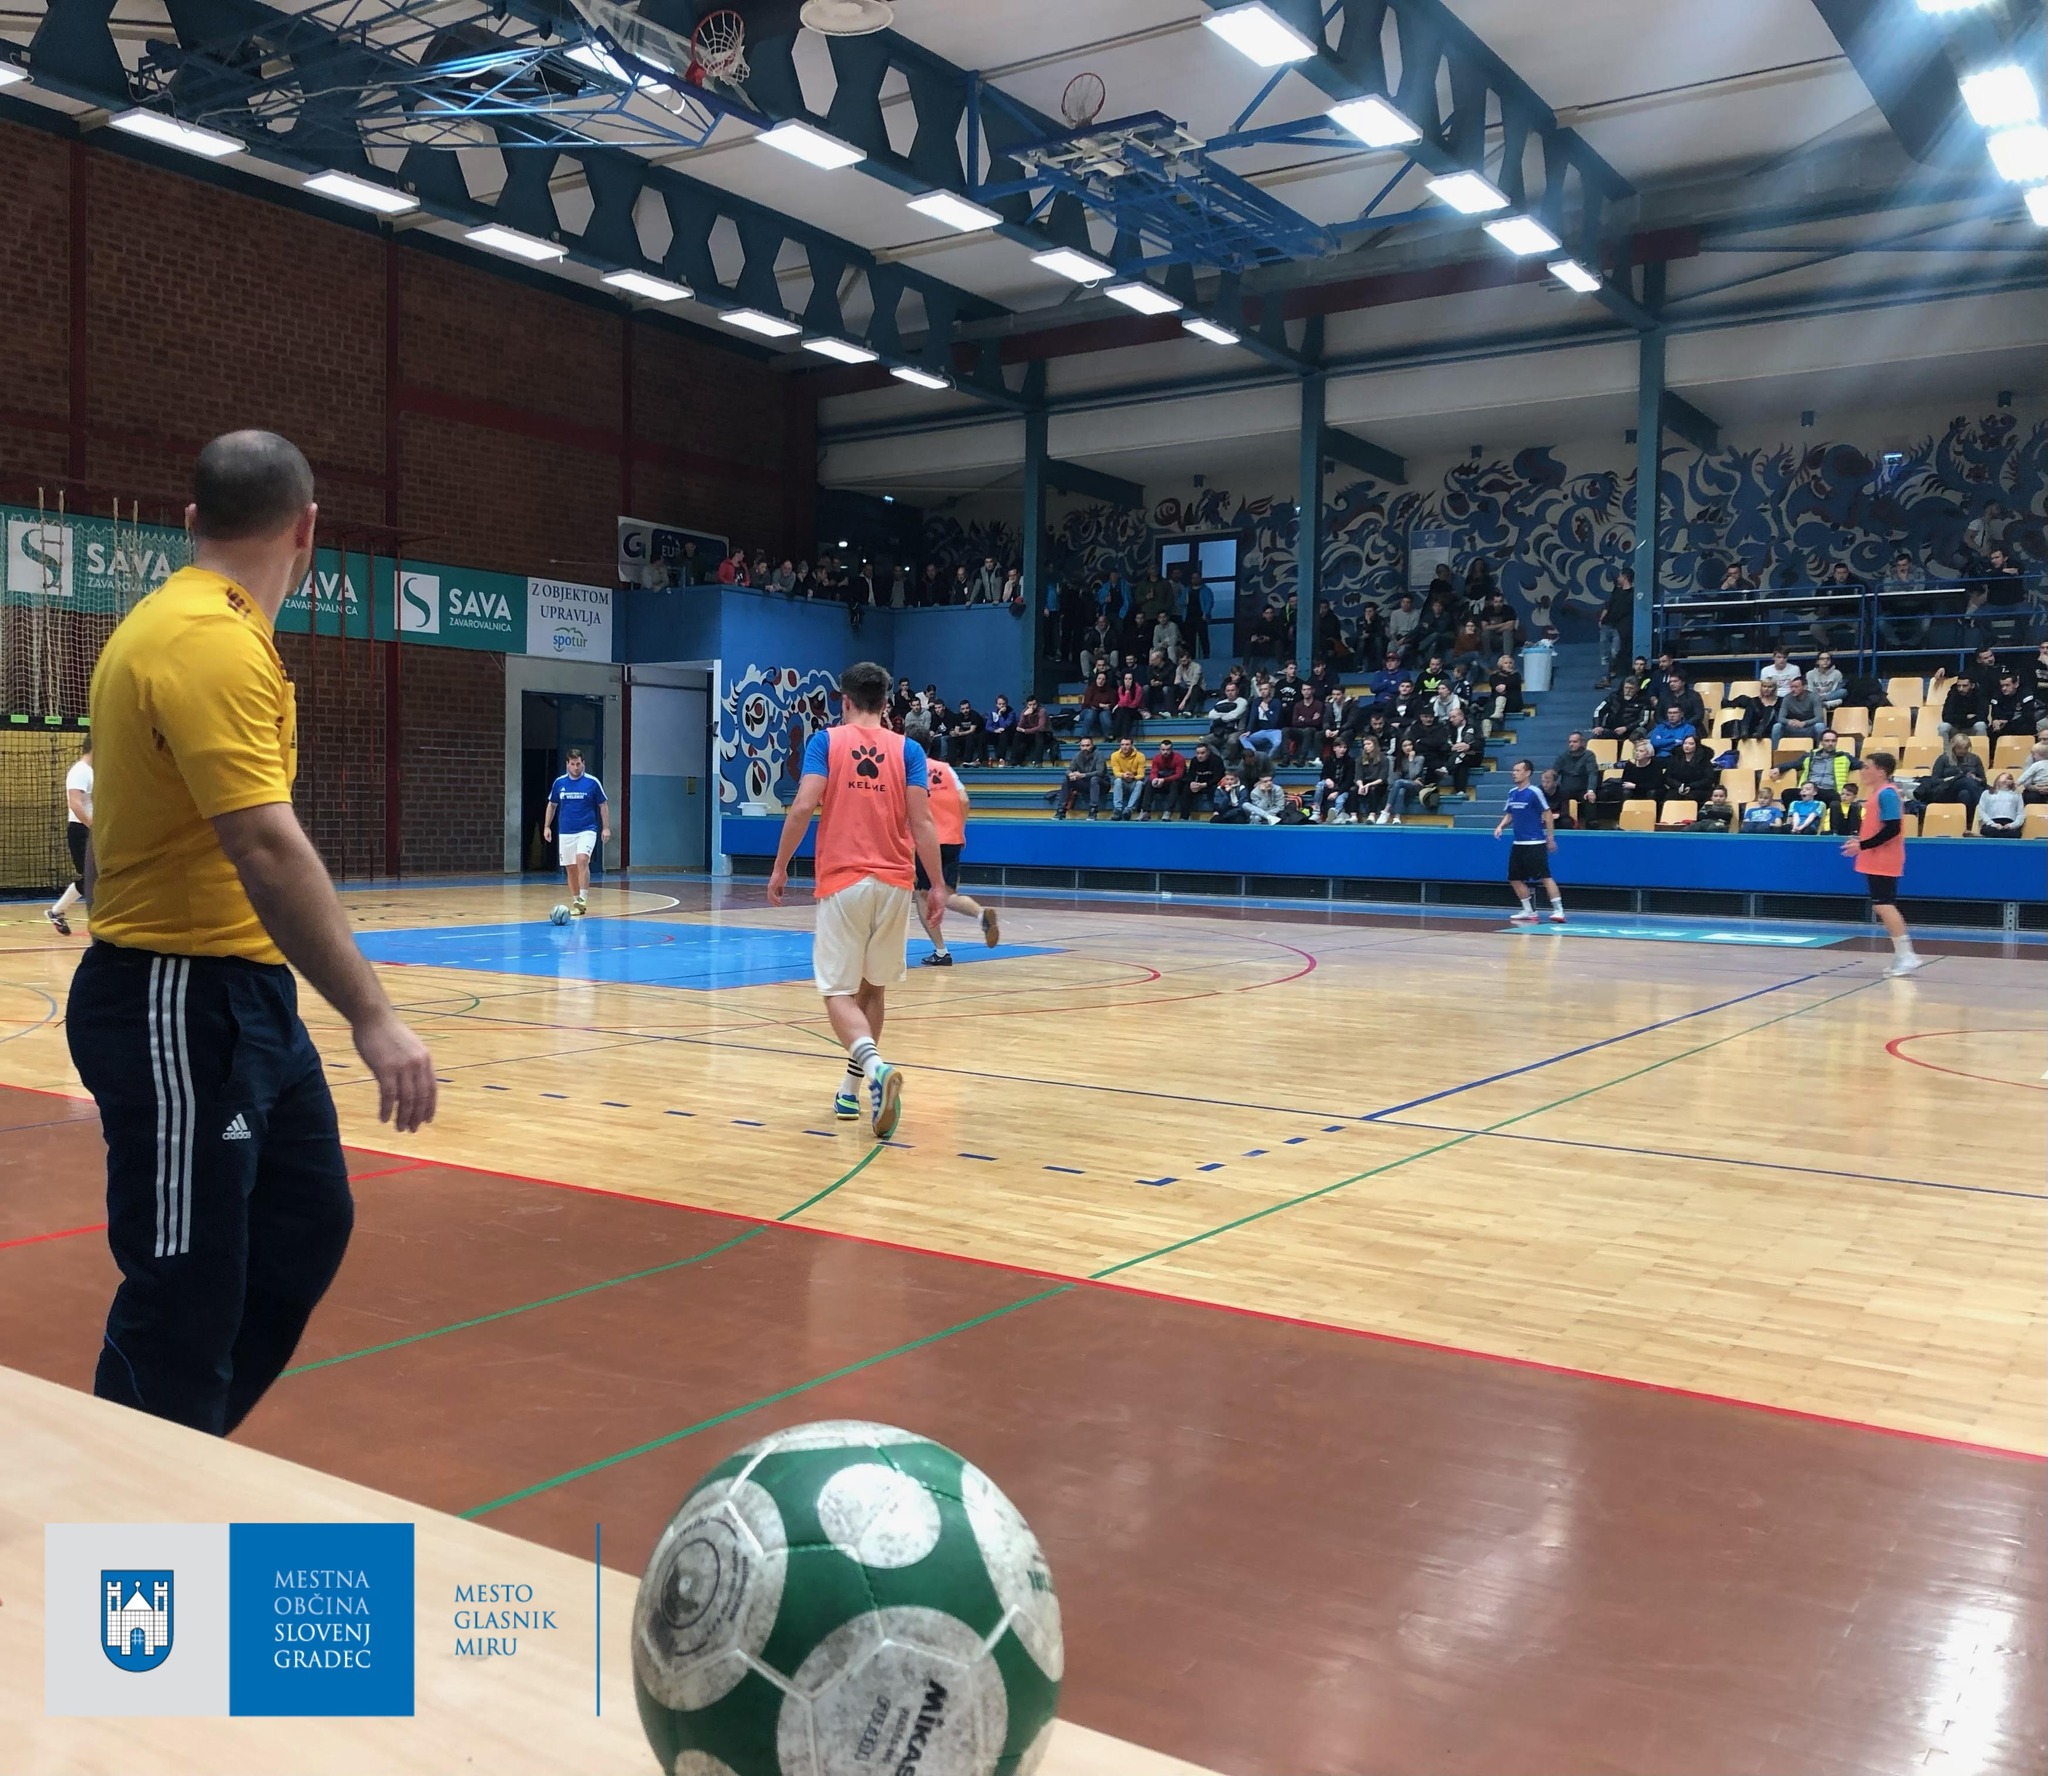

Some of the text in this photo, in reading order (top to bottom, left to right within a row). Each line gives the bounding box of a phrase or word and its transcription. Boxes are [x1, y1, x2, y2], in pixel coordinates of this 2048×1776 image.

[87, 543, 172, 581] SAVA
[292, 570, 358, 603] AVA
[532, 582, 609, 606] Z OBJEKTOM
[449, 587, 512, 621] SAVA
[449, 617, 512, 632] ZAVAROVALNICA
[540, 605, 602, 627] UPRAVLJA
[553, 632, 588, 650] spotur
[848, 781, 886, 792] KELME
[222, 1130, 251, 1140] adidas
